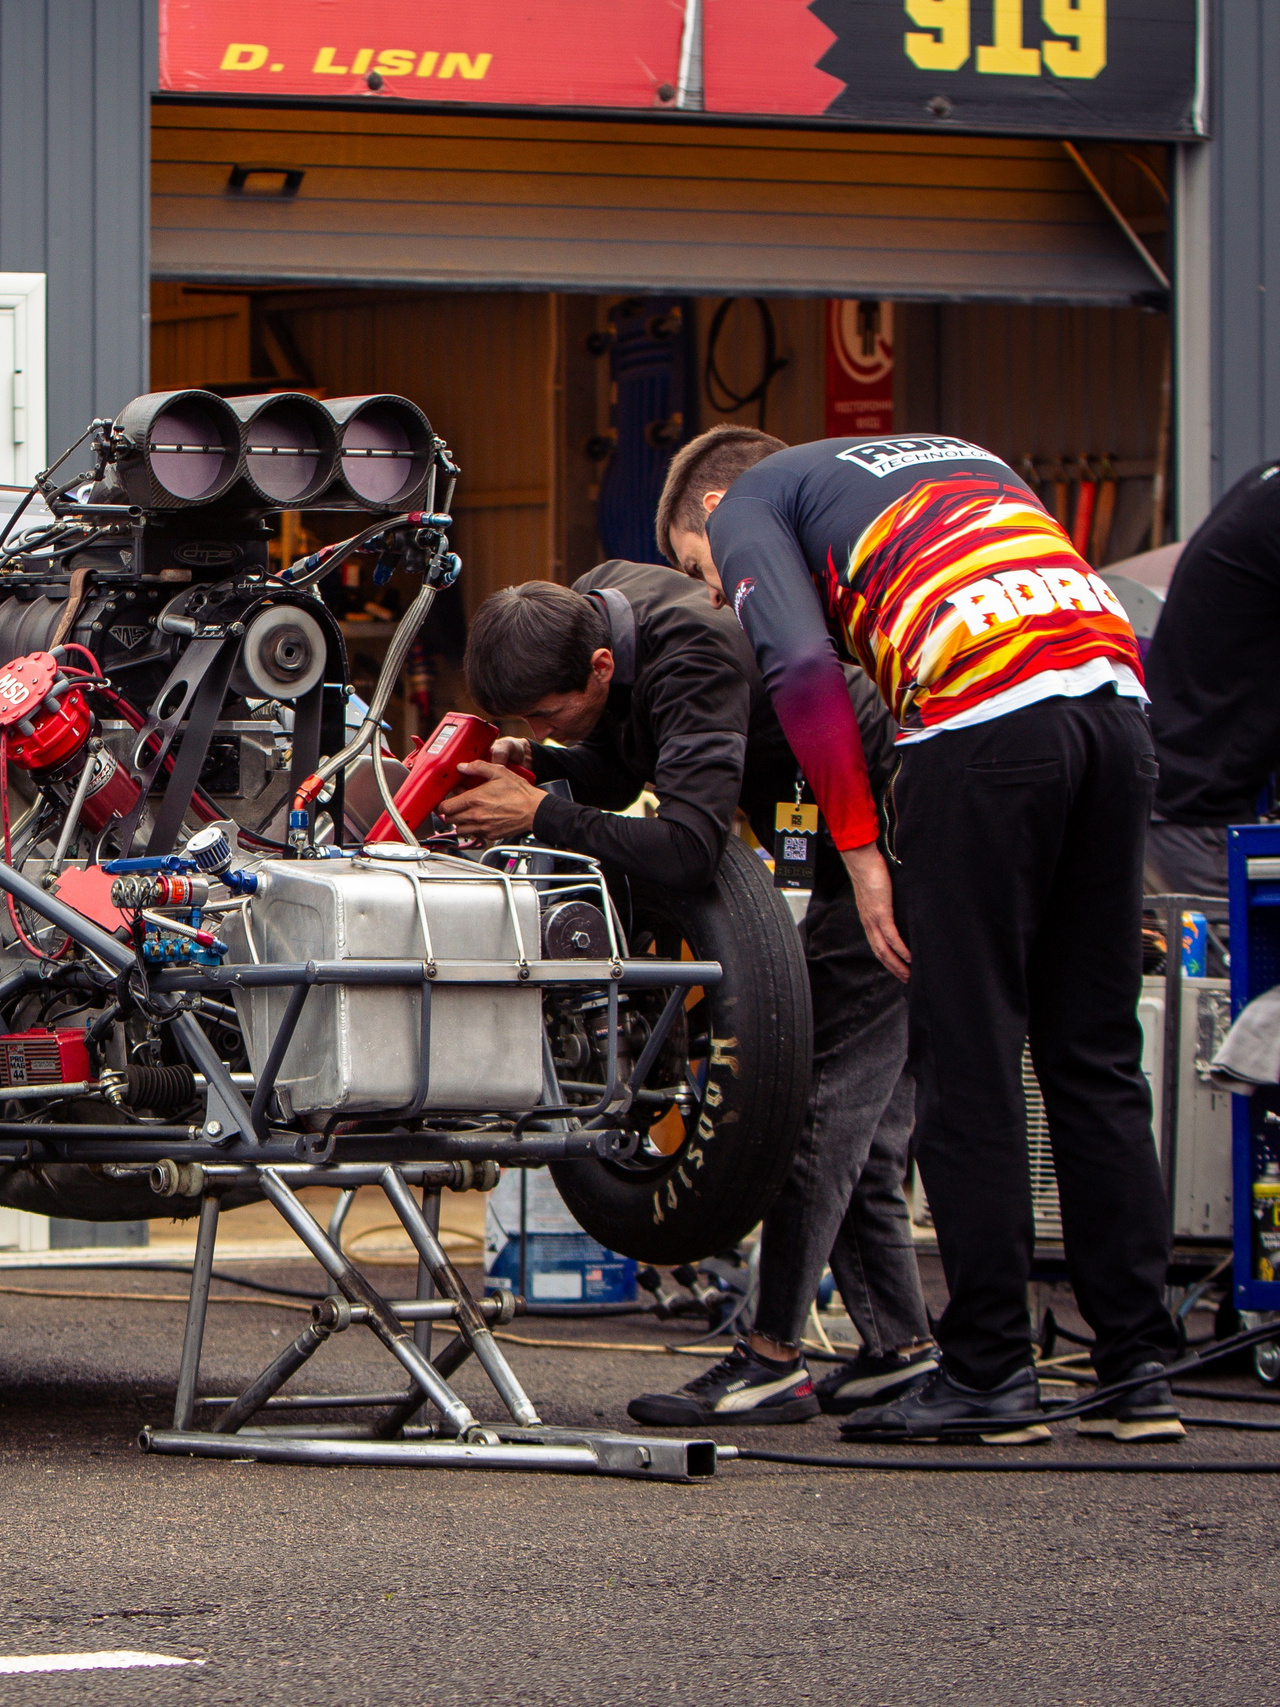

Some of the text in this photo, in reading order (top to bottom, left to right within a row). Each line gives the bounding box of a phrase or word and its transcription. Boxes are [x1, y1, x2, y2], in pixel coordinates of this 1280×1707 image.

[904, 0, 1107, 80] 919
[220, 43, 493, 80] D. LISIN
[169, 875, 185, 905] NOS
[13, 1069, 24, 1080] 44
